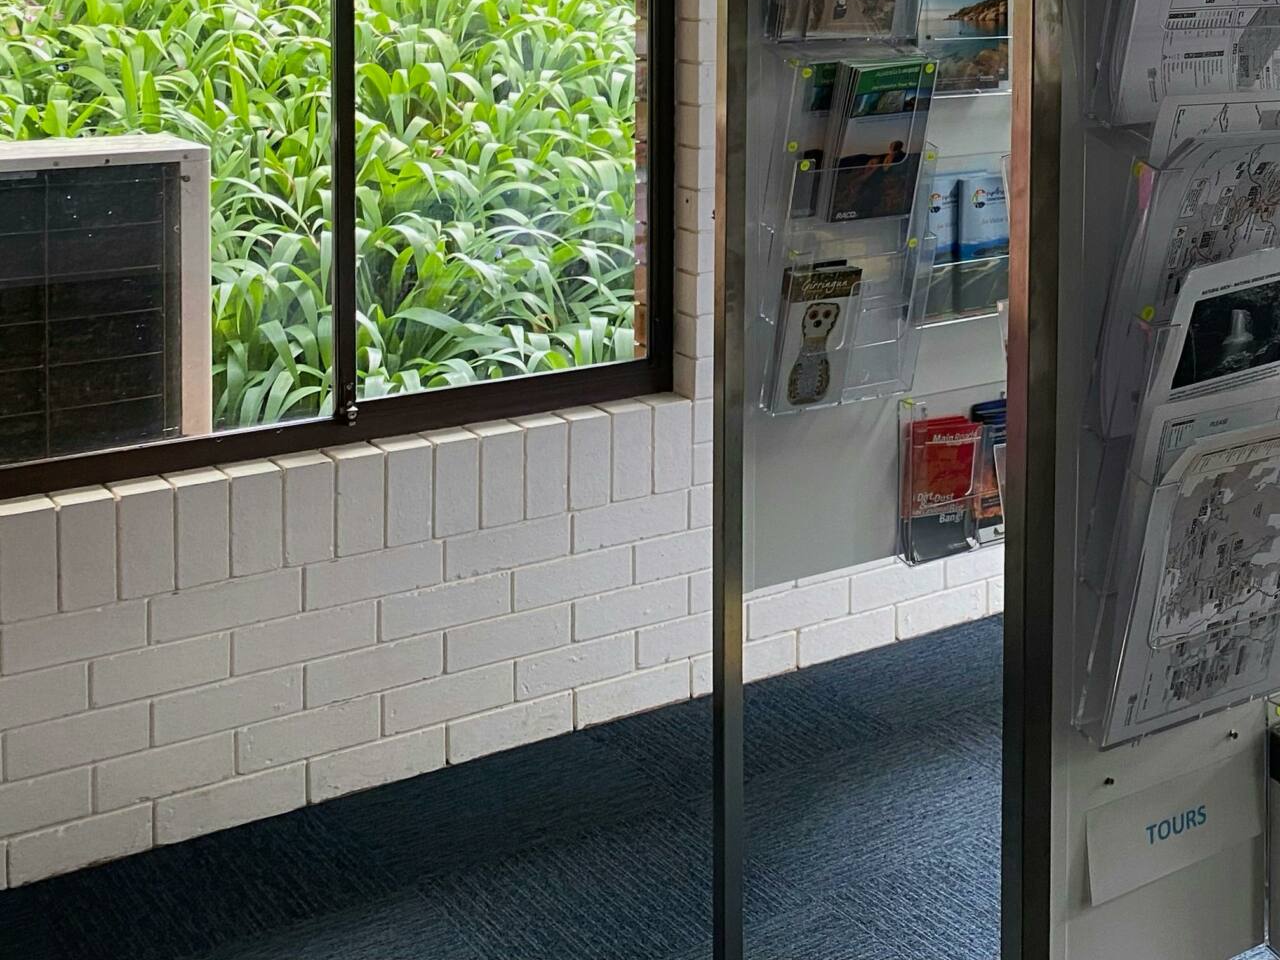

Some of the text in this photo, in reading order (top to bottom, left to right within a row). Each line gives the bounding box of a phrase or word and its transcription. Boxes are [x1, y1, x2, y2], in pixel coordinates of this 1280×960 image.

[932, 433, 954, 443] Main
[934, 492, 954, 503] Dust
[1145, 804, 1208, 845] TOURS
